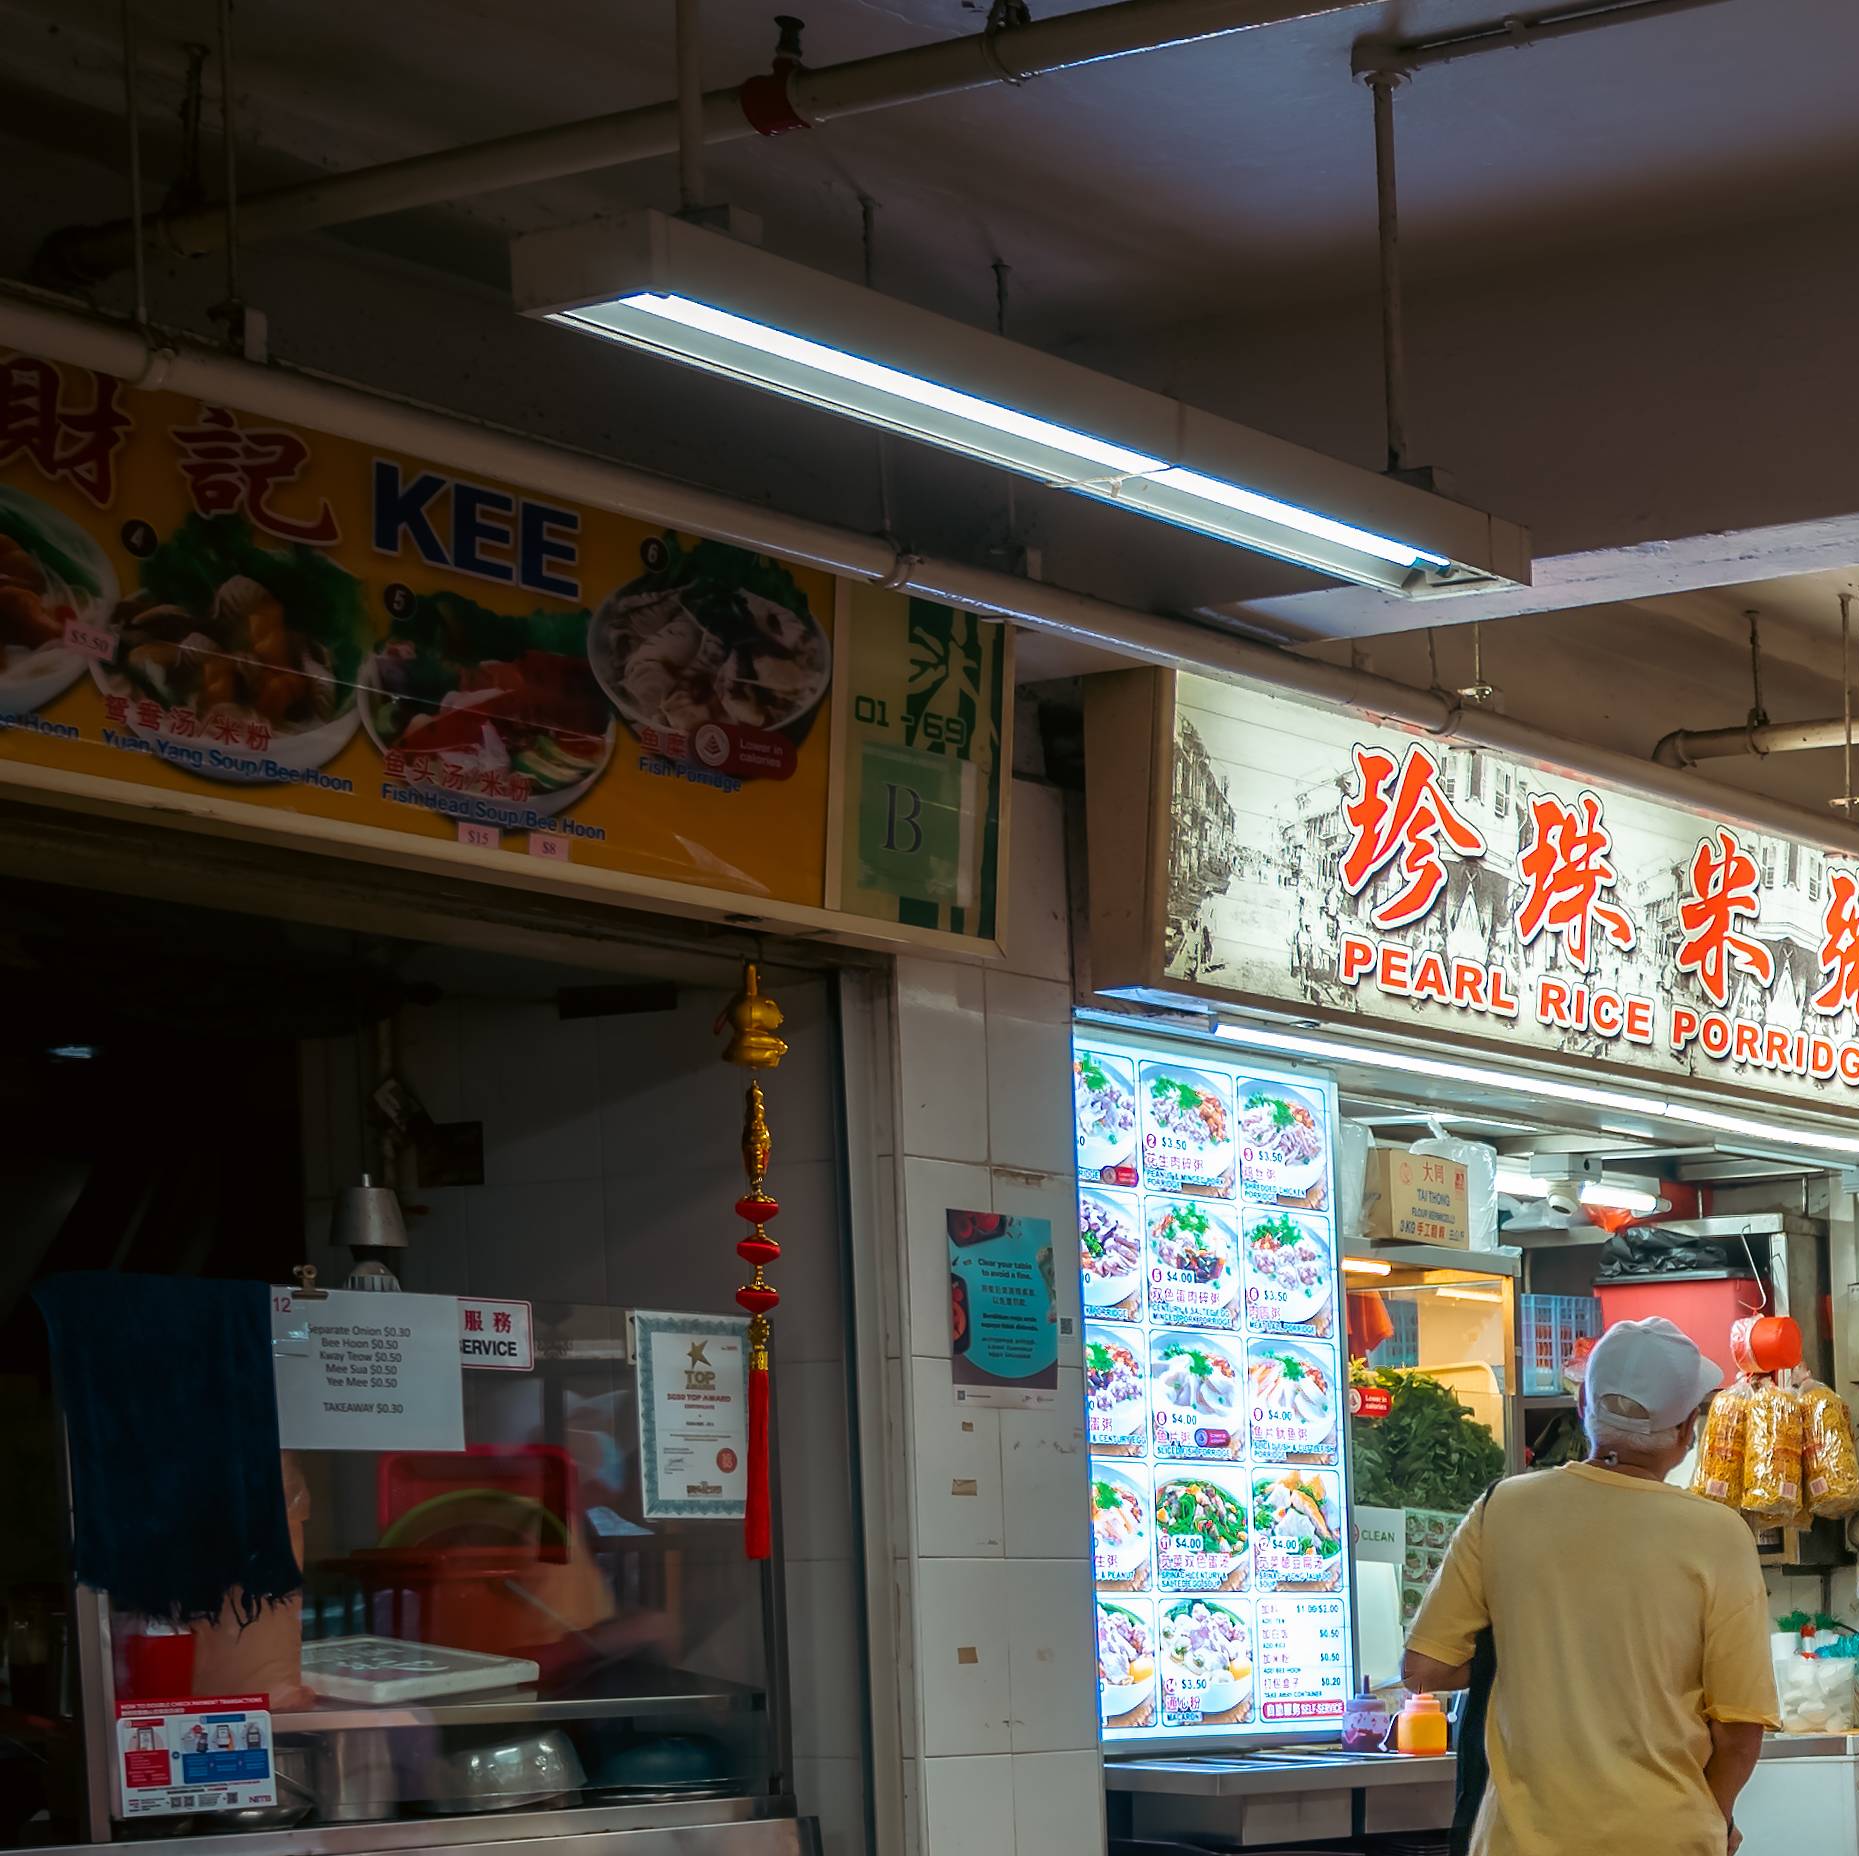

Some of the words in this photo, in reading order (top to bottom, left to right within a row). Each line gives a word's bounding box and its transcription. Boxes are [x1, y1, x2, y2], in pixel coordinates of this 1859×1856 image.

[373, 459, 582, 602] KEE
[739, 738, 771, 755] Lower
[772, 742, 784, 757] in
[103, 728, 150, 752] Yuan
[156, 739, 204, 768] Yang
[304, 768, 354, 793] Hoon
[738, 752, 783, 769] calories
[639, 757, 672, 777] Fish
[675, 764, 744, 793] Porridge
[382, 783, 419, 804] Fish
[425, 790, 469, 815] Head
[562, 818, 606, 841] Hoon
[882, 781, 924, 855] B
[468, 829, 490, 847] $15
[541, 840, 557, 856] $8
[1341, 934, 1519, 1015] PEARL
[1538, 976, 1654, 1043] RICE
[1161, 1136, 1187, 1150] $3.50
[1166, 1272, 1193, 1284] $4.00
[463, 1309, 512, 1334] 服務
[352, 1326, 382, 1337] Onion
[321, 1338, 341, 1349] Bee
[343, 1339, 369, 1350] Hoon
[371, 1339, 399, 1350] $0.50
[346, 1352, 373, 1363] Teow
[326, 1364, 348, 1375] Mee
[350, 1364, 368, 1375] Sua
[346, 1377, 369, 1388] Mee
[684, 1370, 716, 1385] TOP
[323, 1402, 375, 1413] TAKEAWAY
[1172, 1413, 1197, 1426] $4.00
[1175, 1537, 1202, 1550] $4.00
[1361, 1529, 1396, 1544] CLEAN
[1272, 1539, 1297, 1550] $4.00
[1181, 1679, 1207, 1690] $3.50
[1321, 1676, 1341, 1687] $0.20
